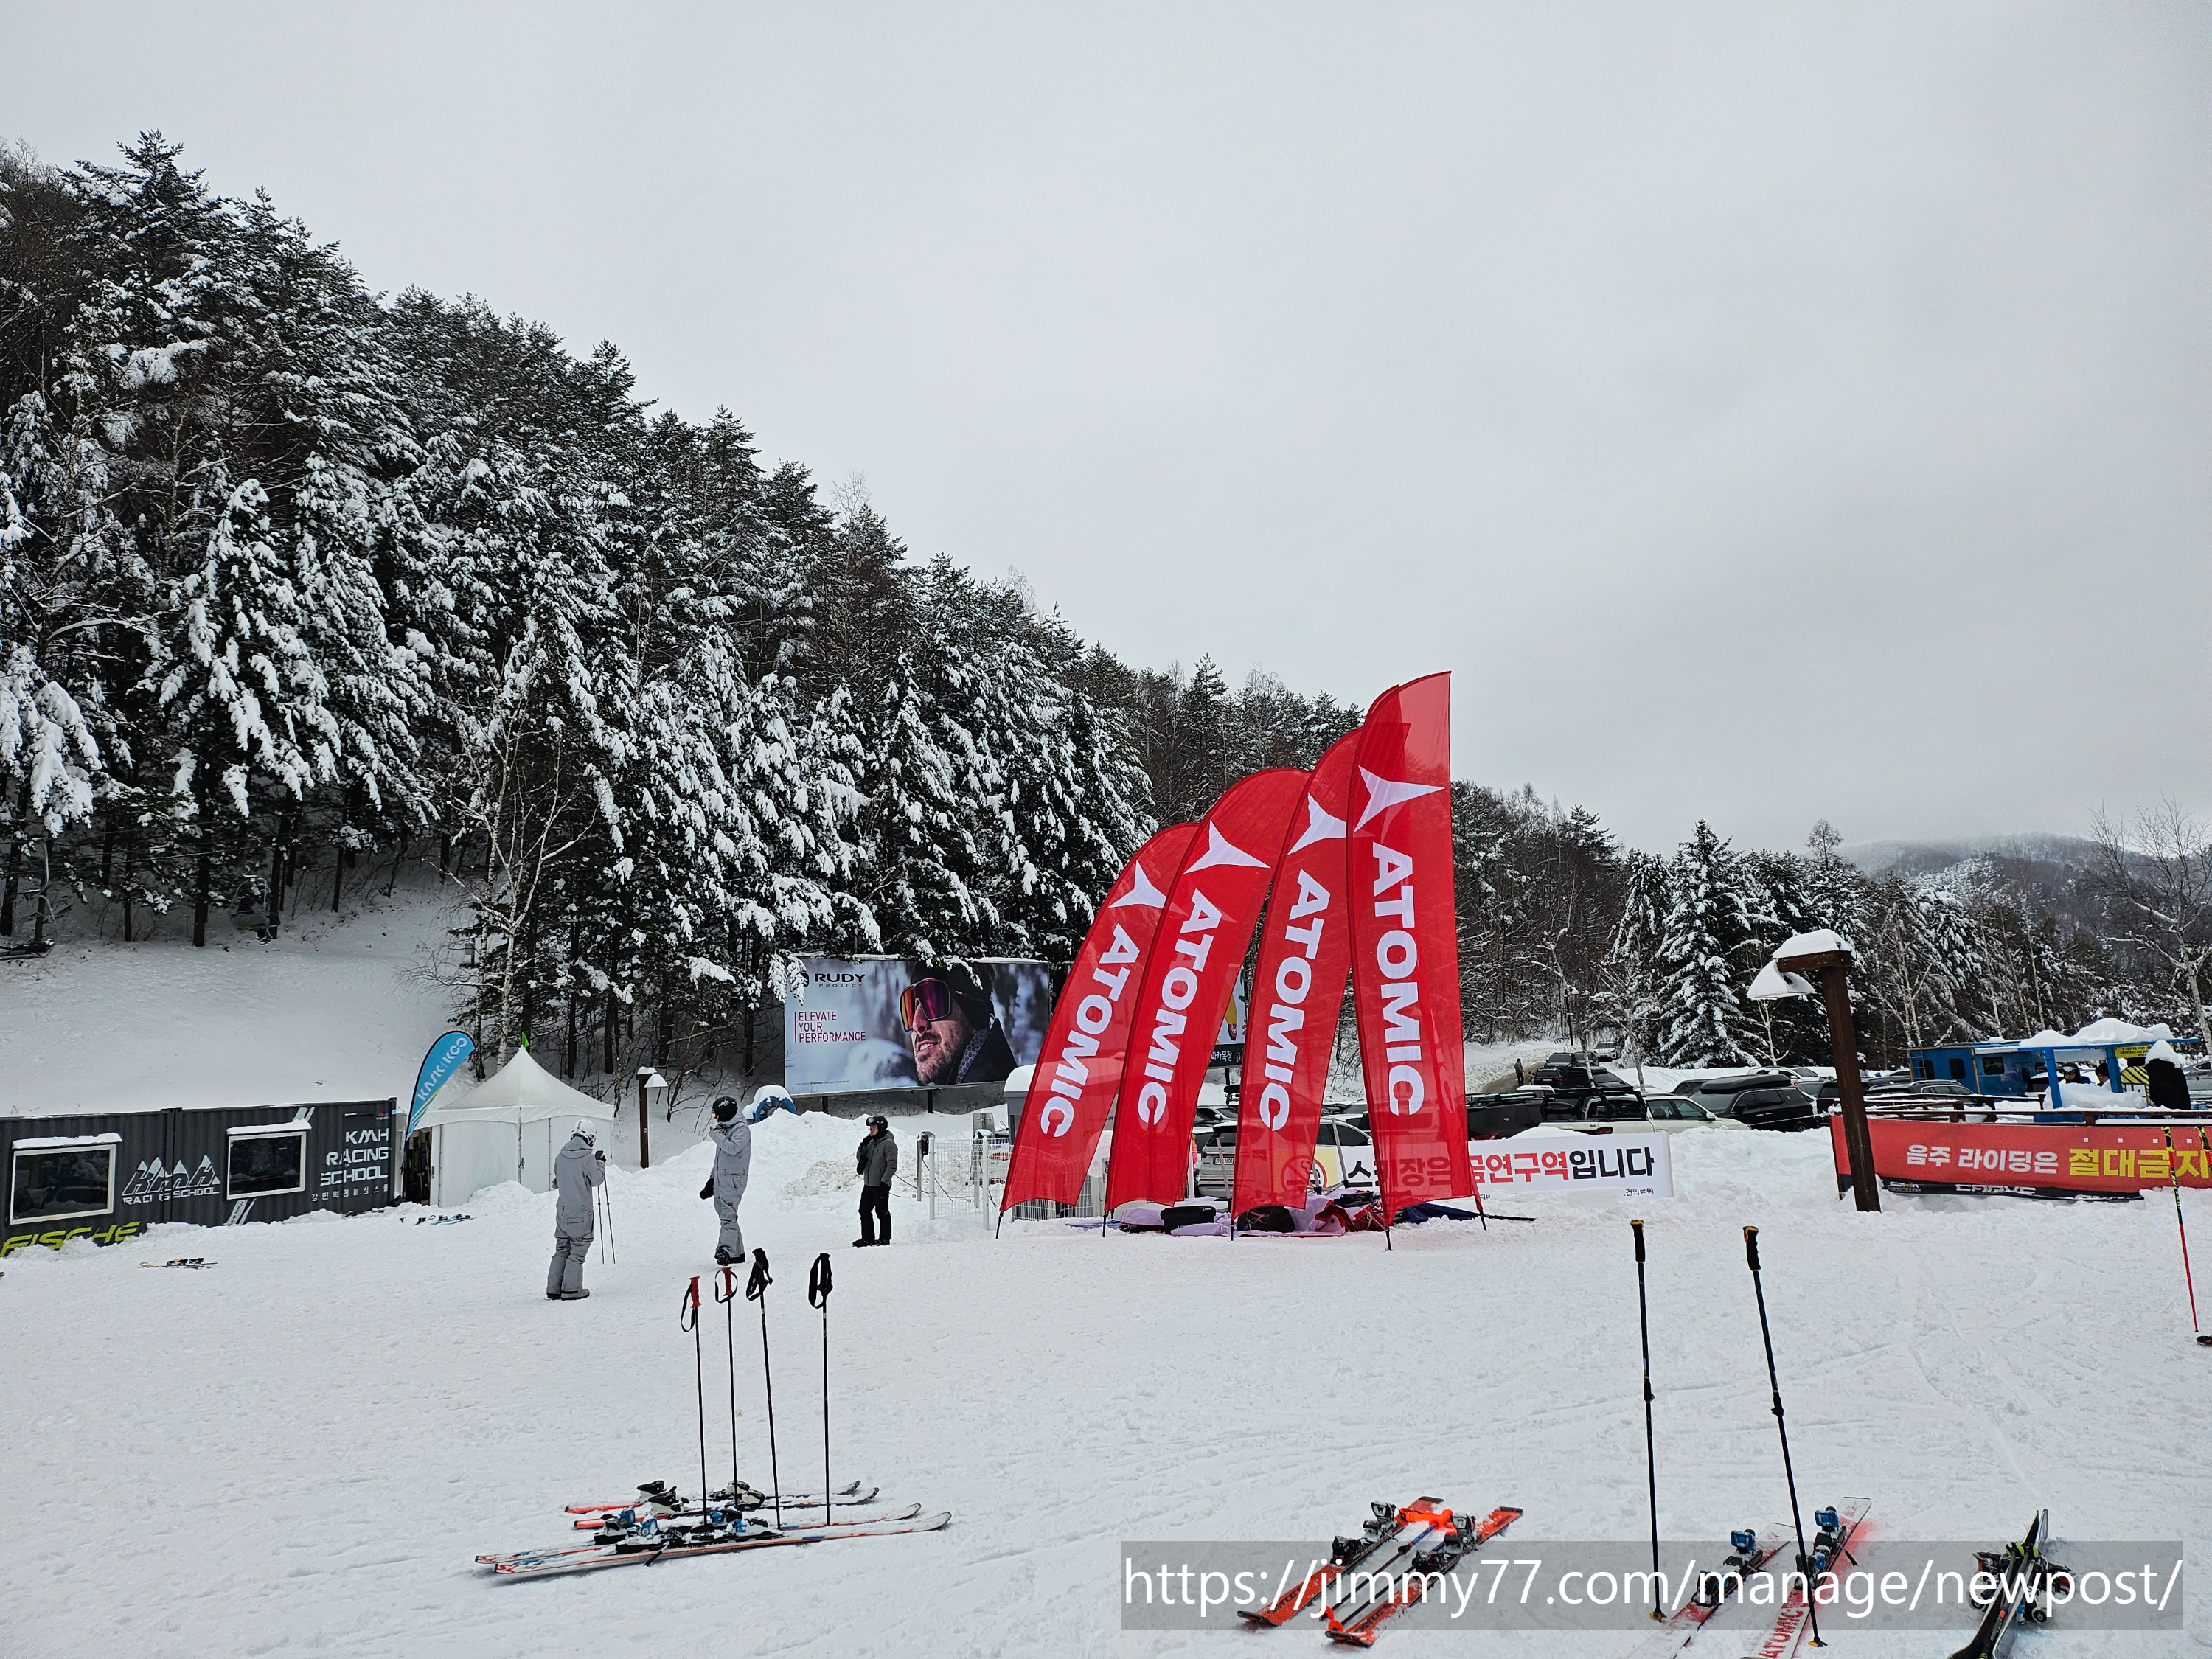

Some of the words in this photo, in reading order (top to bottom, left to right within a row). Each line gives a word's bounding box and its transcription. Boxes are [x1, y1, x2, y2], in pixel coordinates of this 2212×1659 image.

[814, 973, 866, 983] RUDY
[1372, 841, 1425, 1116] ATOMIC
[1138, 888, 1222, 1125] ATOMIC
[1259, 869, 1331, 1131] ATOMIC
[799, 1011, 837, 1021] ELEVATE
[799, 1022, 823, 1032] YOUR
[1040, 922, 1141, 1138] ATOMIC
[799, 1032, 866, 1043] PERFORMANCE
[417, 1065, 445, 1101] KASK
[345, 1128, 389, 1144] KMH
[326, 1147, 389, 1166] RACING
[1907, 1144, 1951, 1166] 음주
[1958, 1148, 2059, 1174] 라이딩은
[2069, 1148, 2211, 1179] 절대금지
[320, 1166, 389, 1186] SCHOOL
[173, 1187, 220, 1197] SCHOOL
